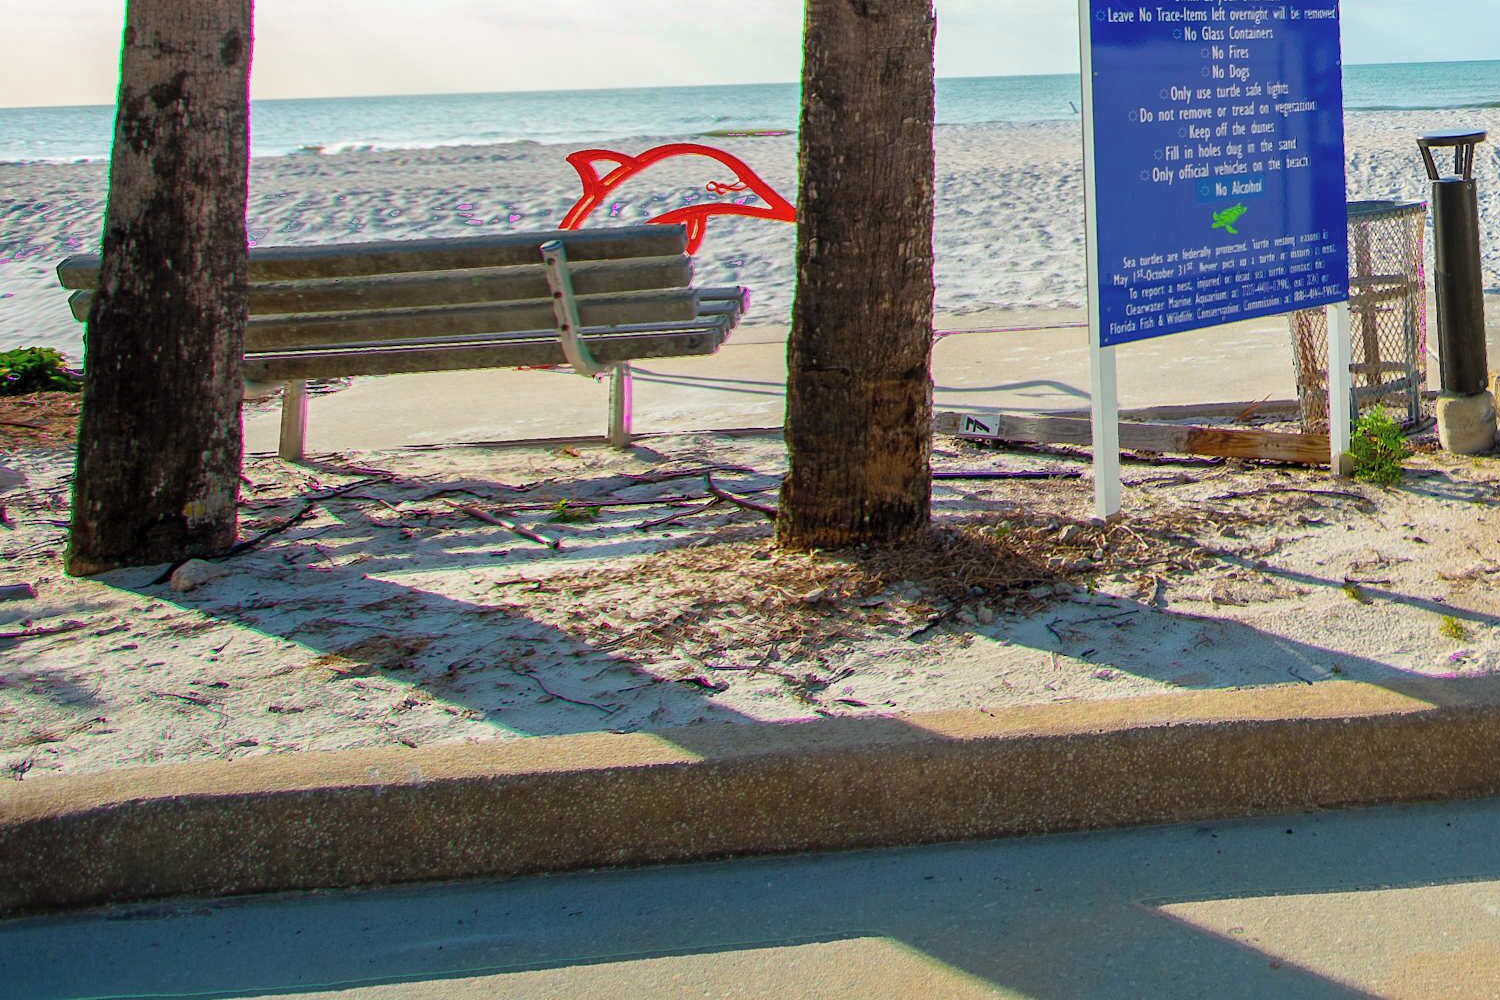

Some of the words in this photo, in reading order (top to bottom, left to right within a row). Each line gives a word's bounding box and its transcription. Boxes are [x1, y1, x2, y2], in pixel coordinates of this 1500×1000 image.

[1107, 7, 1134, 22] Leave
[1139, 7, 1152, 22] No
[1156, 7, 1207, 22] Trace-Items
[1212, 7, 1226, 21] left
[1230, 6, 1268, 24] overnight
[1273, 6, 1286, 19] will
[1291, 6, 1301, 19] be
[1304, 5, 1336, 19] removed
[1184, 26, 1197, 41] No
[1201, 26, 1225, 41] Glass
[1229, 26, 1274, 40] Containers
[1212, 46, 1224, 60] No
[1229, 45, 1249, 59] Fires
[1212, 65, 1225, 79] No
[1229, 64, 1250, 82] Dogs
[1170, 86, 1191, 104] Only
[1196, 88, 1212, 100] use
[1216, 83, 1241, 98] turtle
[1245, 82, 1262, 97] safe
[1266, 80, 1289, 99] lights
[1139, 107, 1153, 123] Do
[1158, 109, 1174, 121] not
[1179, 107, 1212, 120] remove
[1217, 106, 1227, 117] or
[1231, 101, 1255, 116] tread
[1259, 103, 1270, 113] on
[1275, 100, 1317, 117] vegetation
[1189, 123, 1211, 141] Keep
[1215, 122, 1228, 137] off
[1232, 121, 1246, 135] the
[1251, 120, 1275, 134] dunes
[1165, 145, 1179, 161] Fill
[1184, 144, 1193, 159] in
[1198, 143, 1221, 158] holes
[1226, 140, 1243, 159] dug
[1247, 139, 1255, 153] in
[1260, 138, 1273, 152] the
[1278, 136, 1297, 150] sand
[1152, 167, 1174, 185] Only
[1178, 162, 1209, 180] official
[1213, 159, 1248, 176] vehicles
[1252, 161, 1262, 172] on
[1268, 156, 1281, 170] the
[1286, 154, 1310, 169] beach
[1215, 183, 1228, 197] No
[1231, 179, 1262, 195] Alcohol
[1122, 256, 1136, 269] Sea
[1139, 252, 1163, 267] turtles
[1167, 252, 1178, 263] are
[1182, 246, 1211, 260] federally
[1251, 238, 1270, 249] Turtle
[1113, 274, 1128, 288] May
[1259, 252, 1276, 264] turtle
[1129, 288, 1138, 300] To
[1141, 285, 1165, 300] report
[1168, 285, 1173, 294] a
[1196, 276, 1220, 290] injured
[1125, 301, 1165, 317] Clearwater
[1195, 290, 1227, 306] Aquarium
[1109, 320, 1136, 335] Florida
[1139, 316, 1155, 331] Fish
[1157, 314, 1164, 327] &
[1165, 311, 1193, 325] Wildlife
